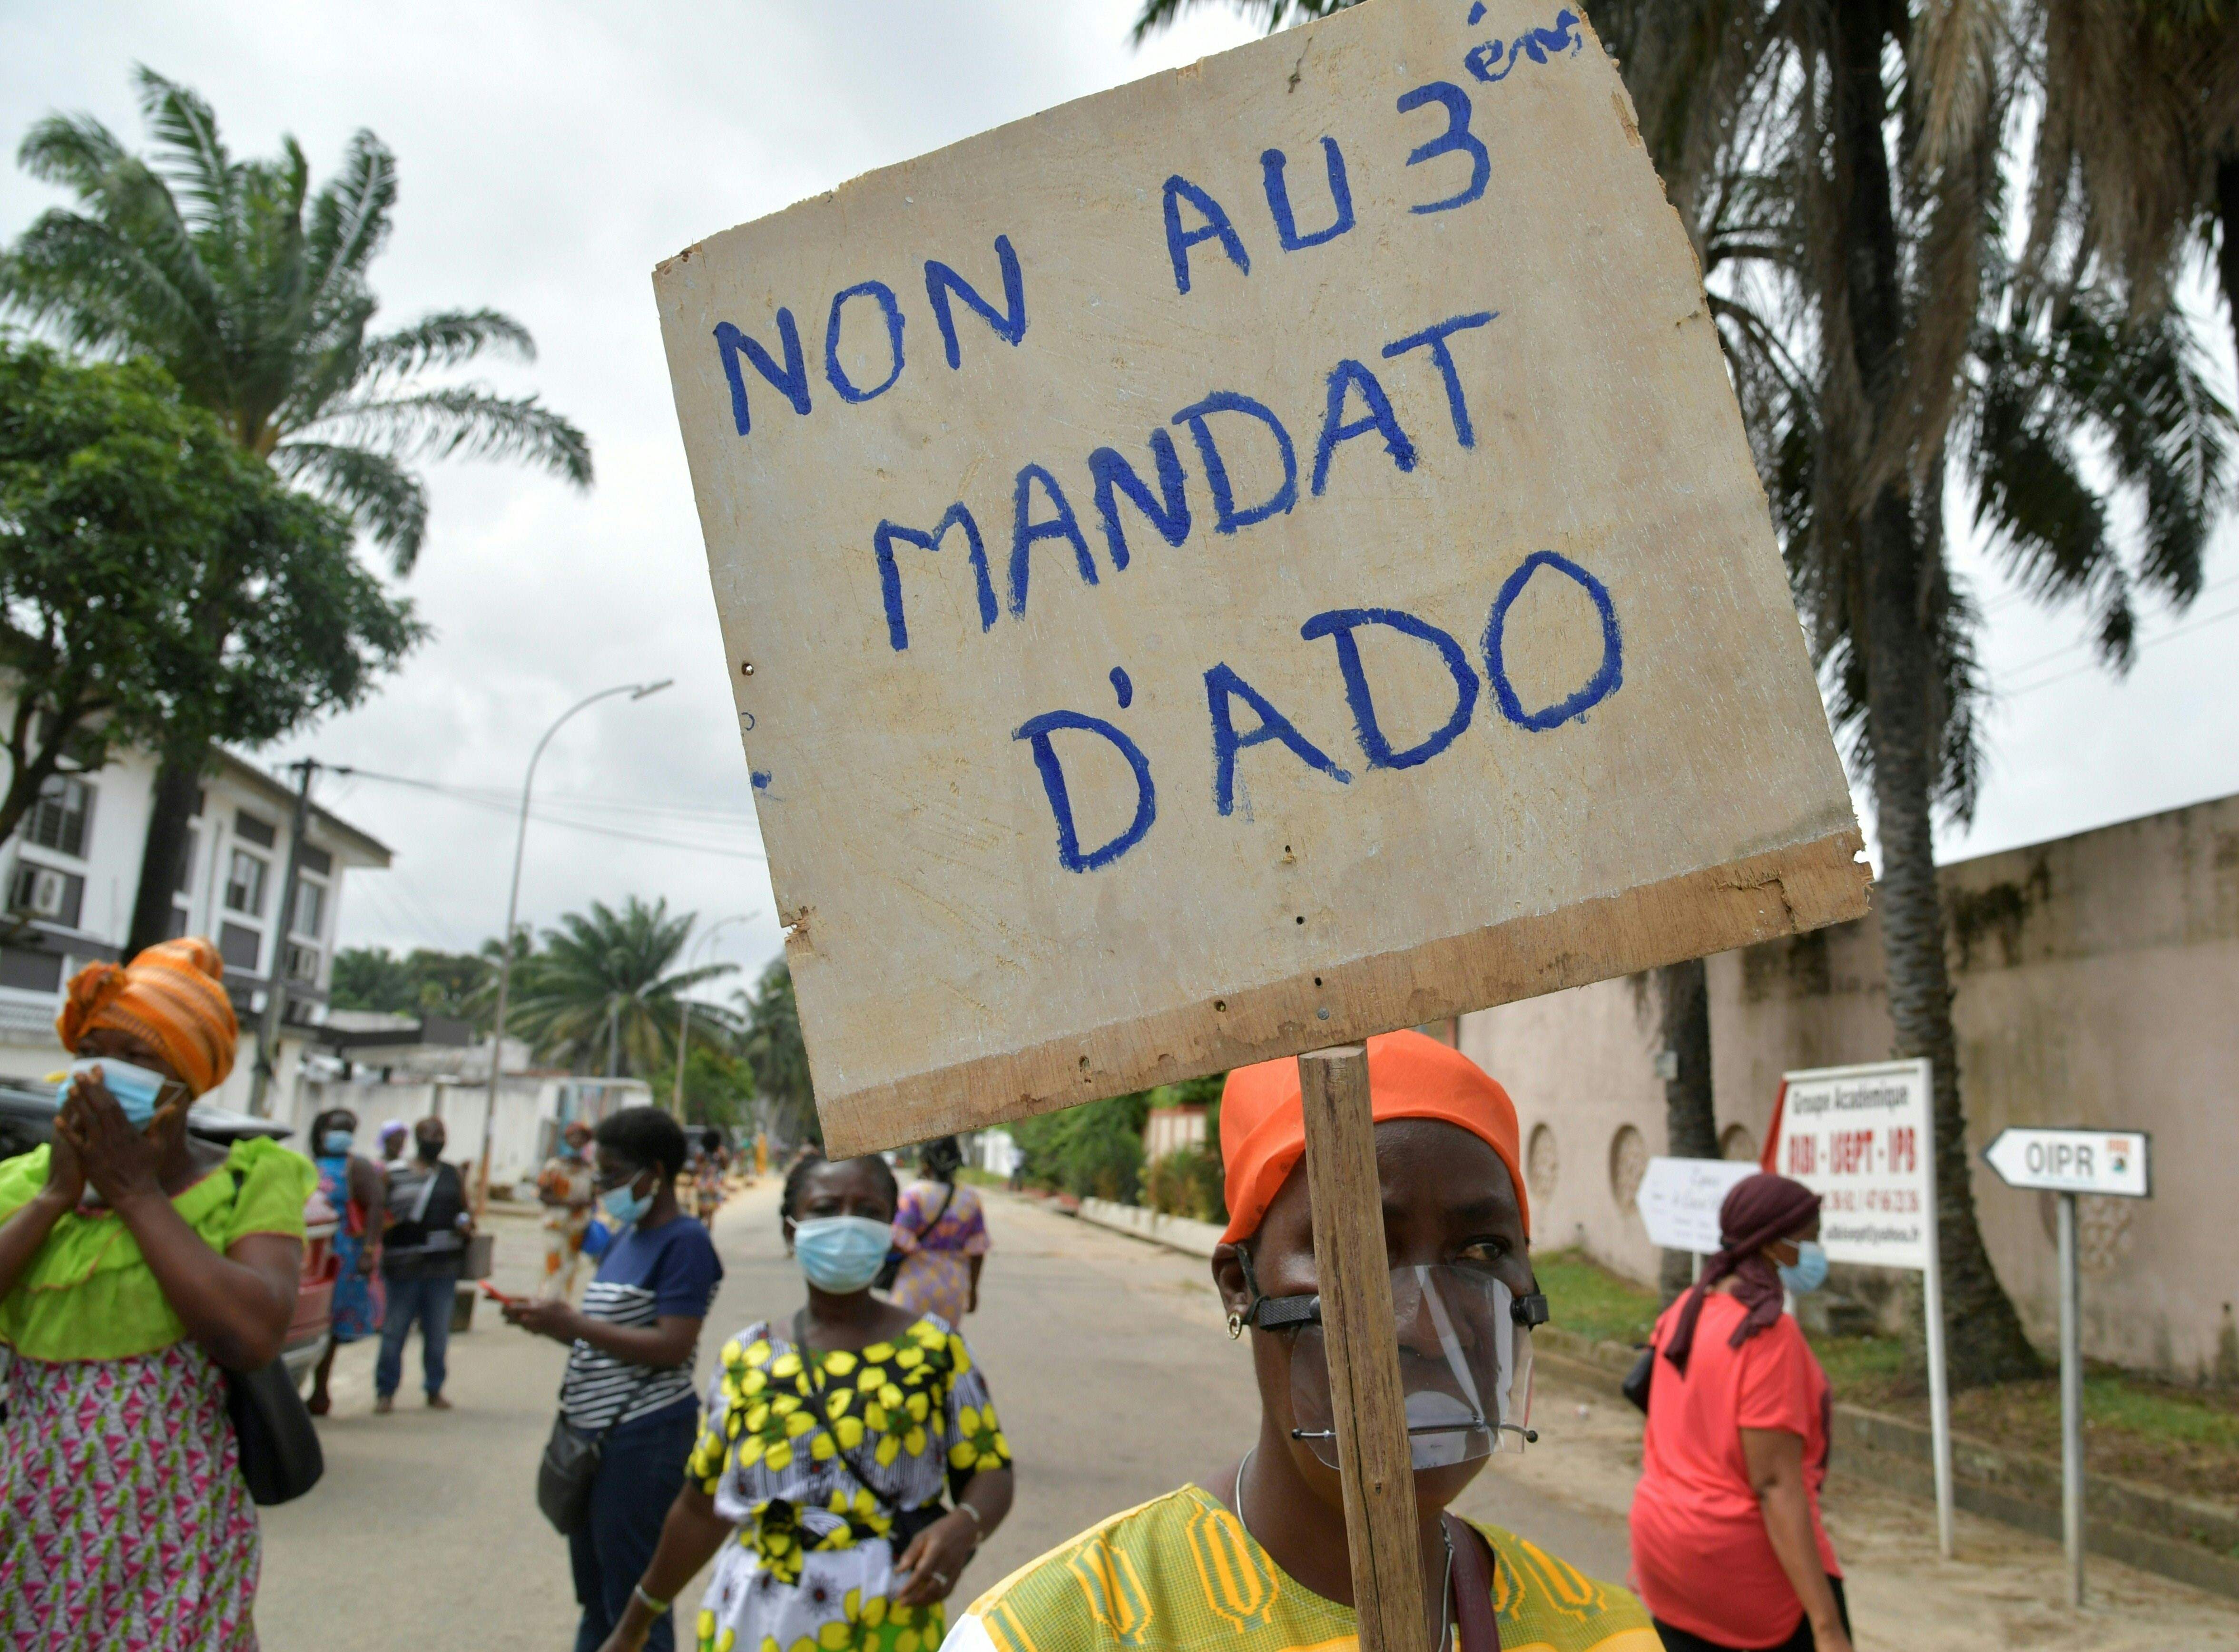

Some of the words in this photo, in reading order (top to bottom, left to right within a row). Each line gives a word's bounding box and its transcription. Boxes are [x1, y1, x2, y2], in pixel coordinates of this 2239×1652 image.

[715, 235, 1026, 437] NON
[1163, 137, 1355, 294] AU
[874, 312, 1497, 651] MANDAT
[1018, 551, 1623, 873] D'ADO
[1794, 1092, 1829, 1117] Groupe
[2026, 1142, 2093, 1177] OIPR
